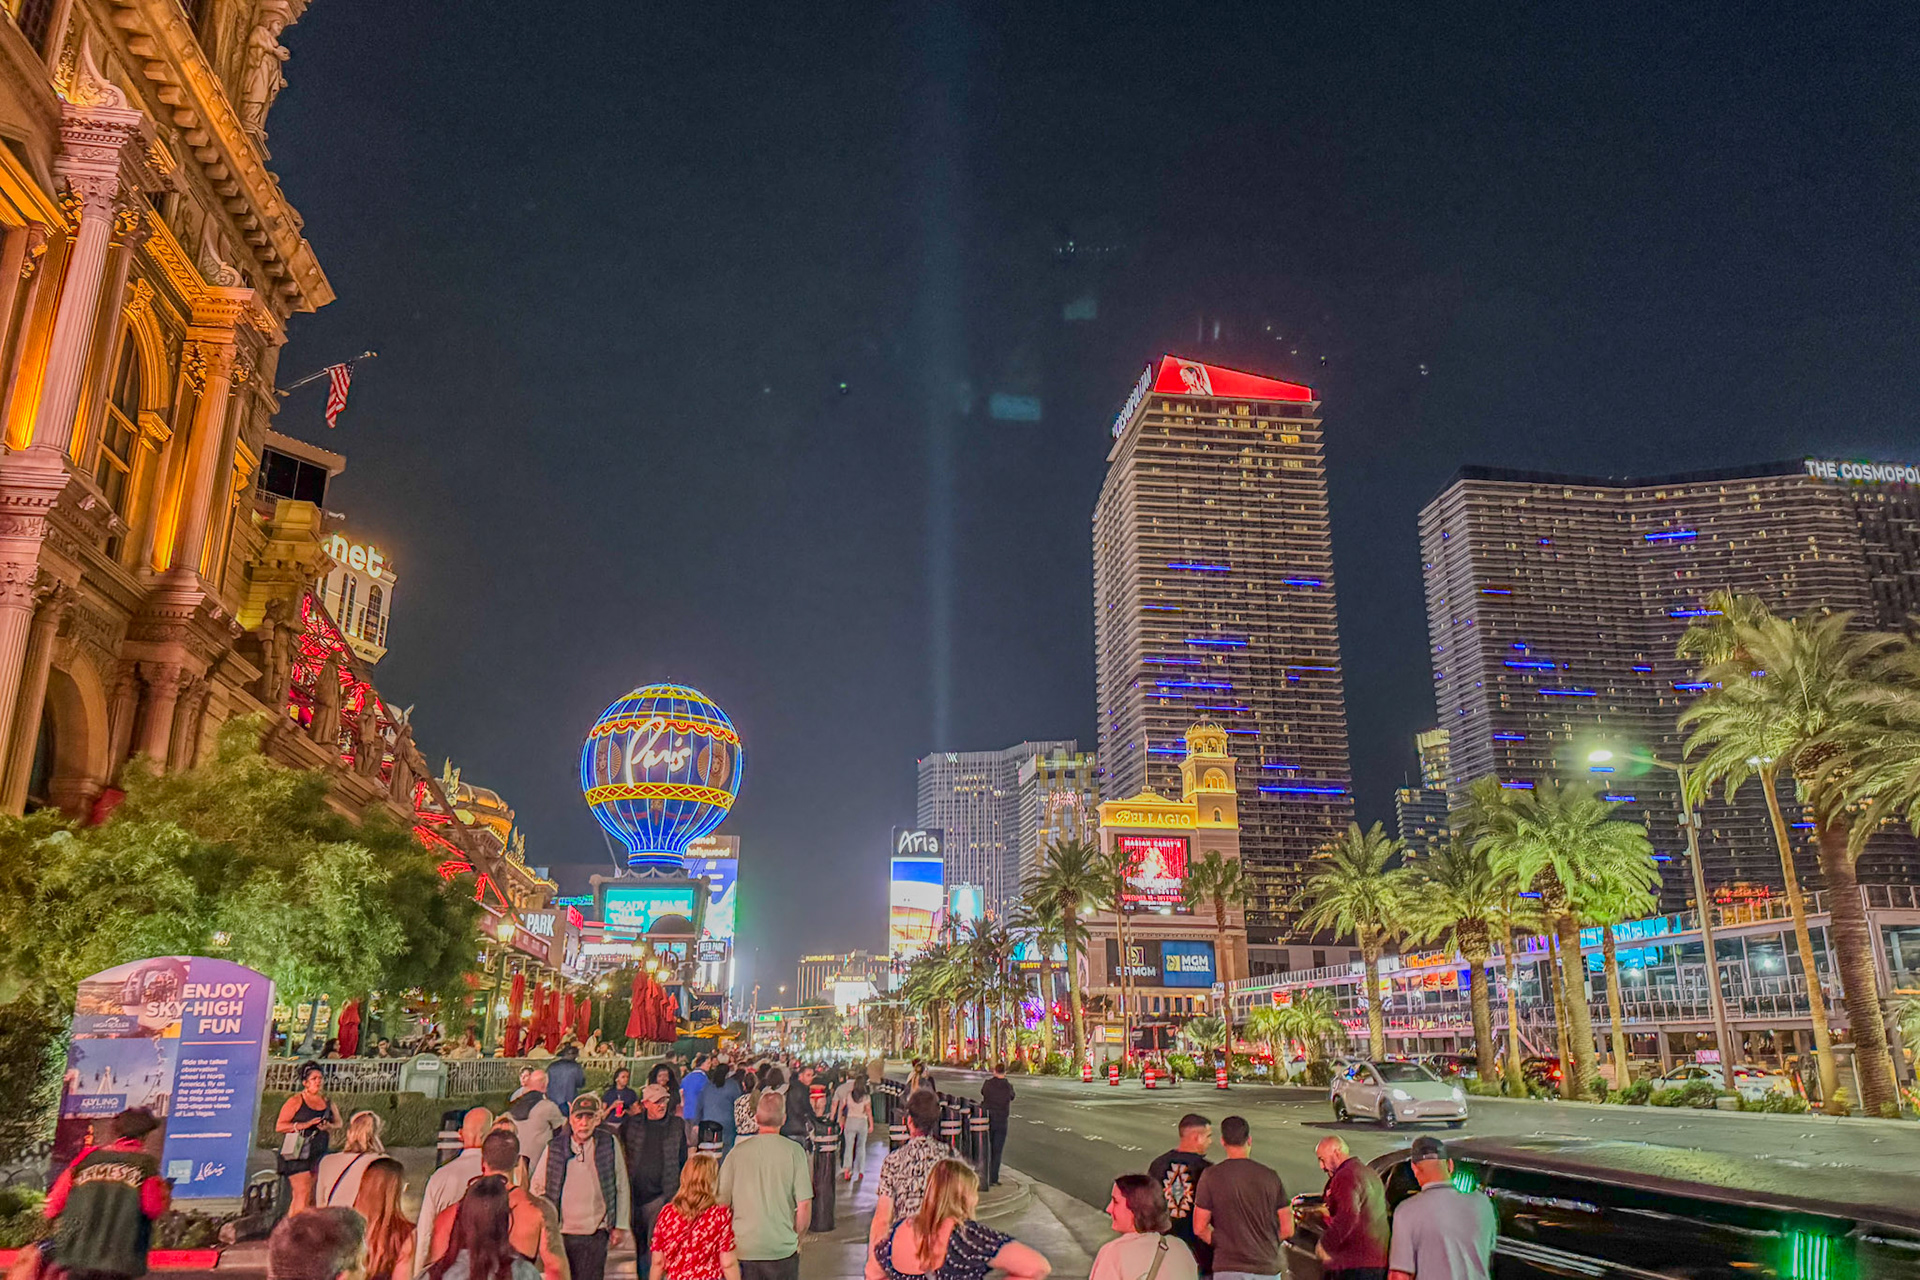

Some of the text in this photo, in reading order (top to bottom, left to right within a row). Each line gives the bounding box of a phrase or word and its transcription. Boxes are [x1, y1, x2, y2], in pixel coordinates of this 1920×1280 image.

[1804, 460, 1838, 478] THE
[626, 716, 691, 789] Paris
[686, 847, 730, 858] hollywood
[526, 913, 556, 937] PARK
[712, 942, 725, 953] PARK
[1181, 955, 1209, 966] MGM
[182, 983, 250, 998] ENJOY
[145, 1001, 244, 1018] SKY-HIGH
[198, 1018, 242, 1034] FUN
[207, 1080, 216, 1088] fly
